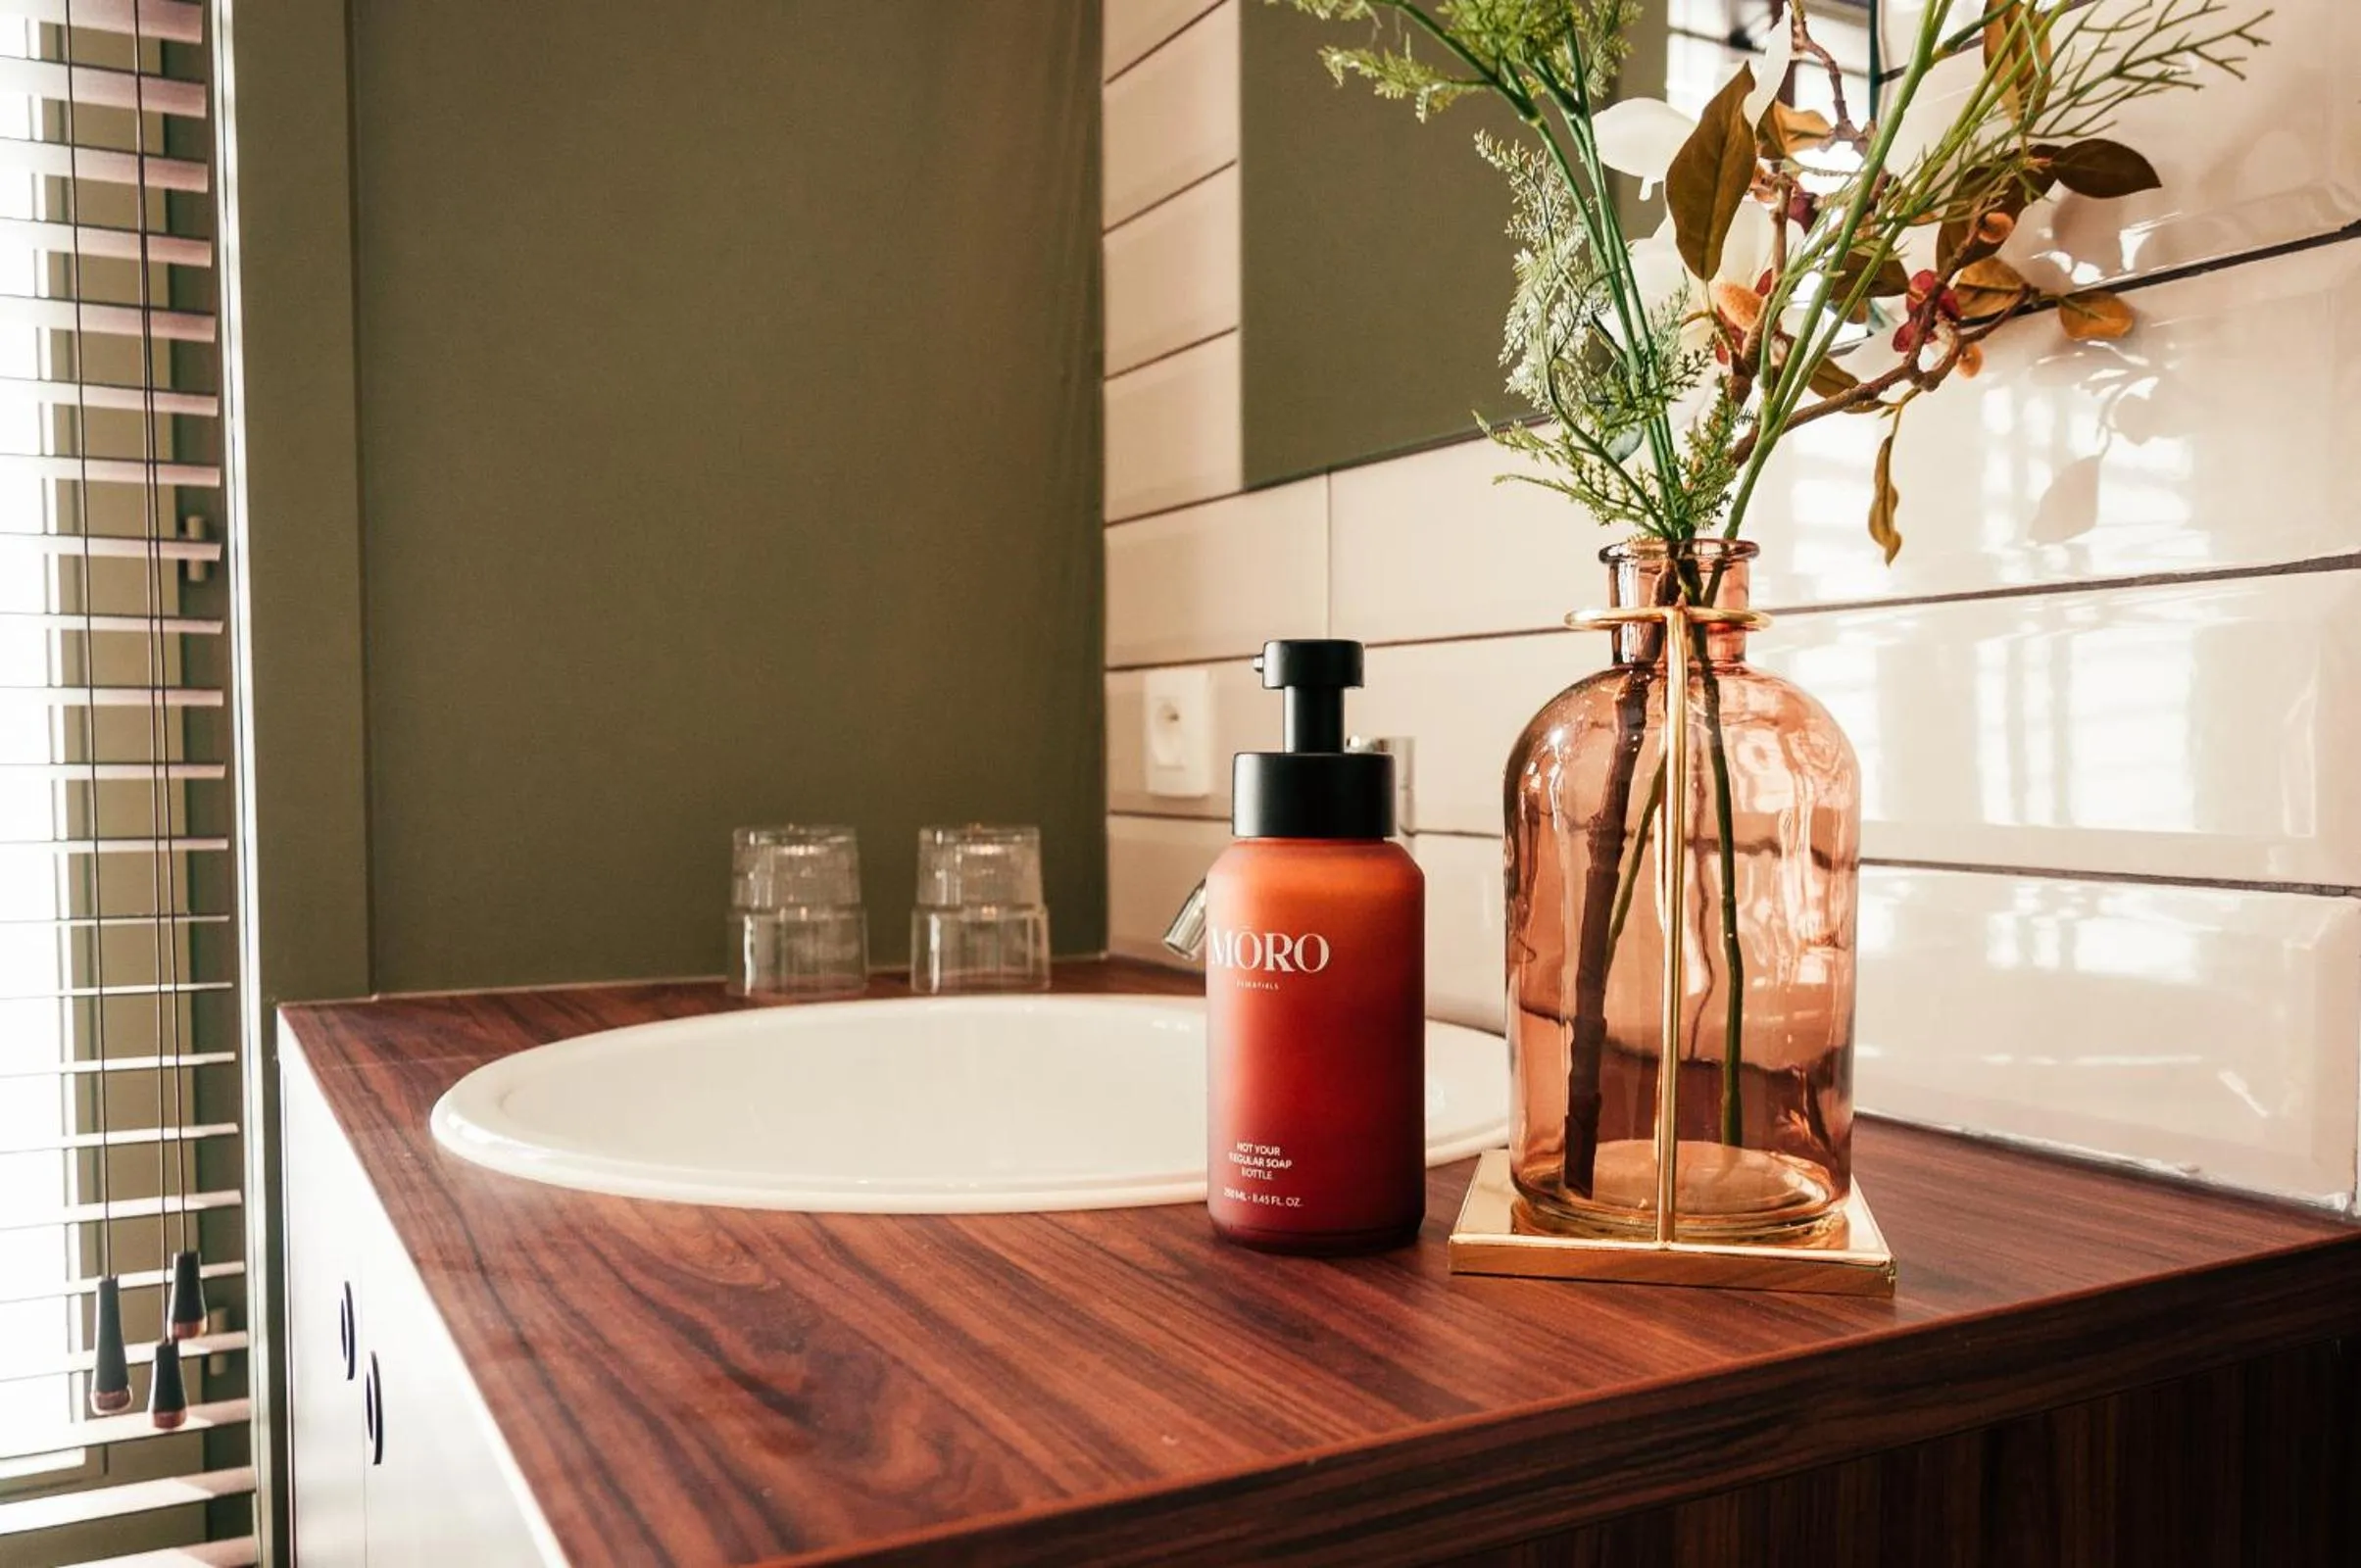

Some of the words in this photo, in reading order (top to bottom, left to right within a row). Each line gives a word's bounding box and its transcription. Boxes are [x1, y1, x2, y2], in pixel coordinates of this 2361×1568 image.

[1237, 1143, 1254, 1153] NOT
[1254, 1145, 1281, 1156] YOUR
[1266, 1158, 1293, 1169] SOAP
